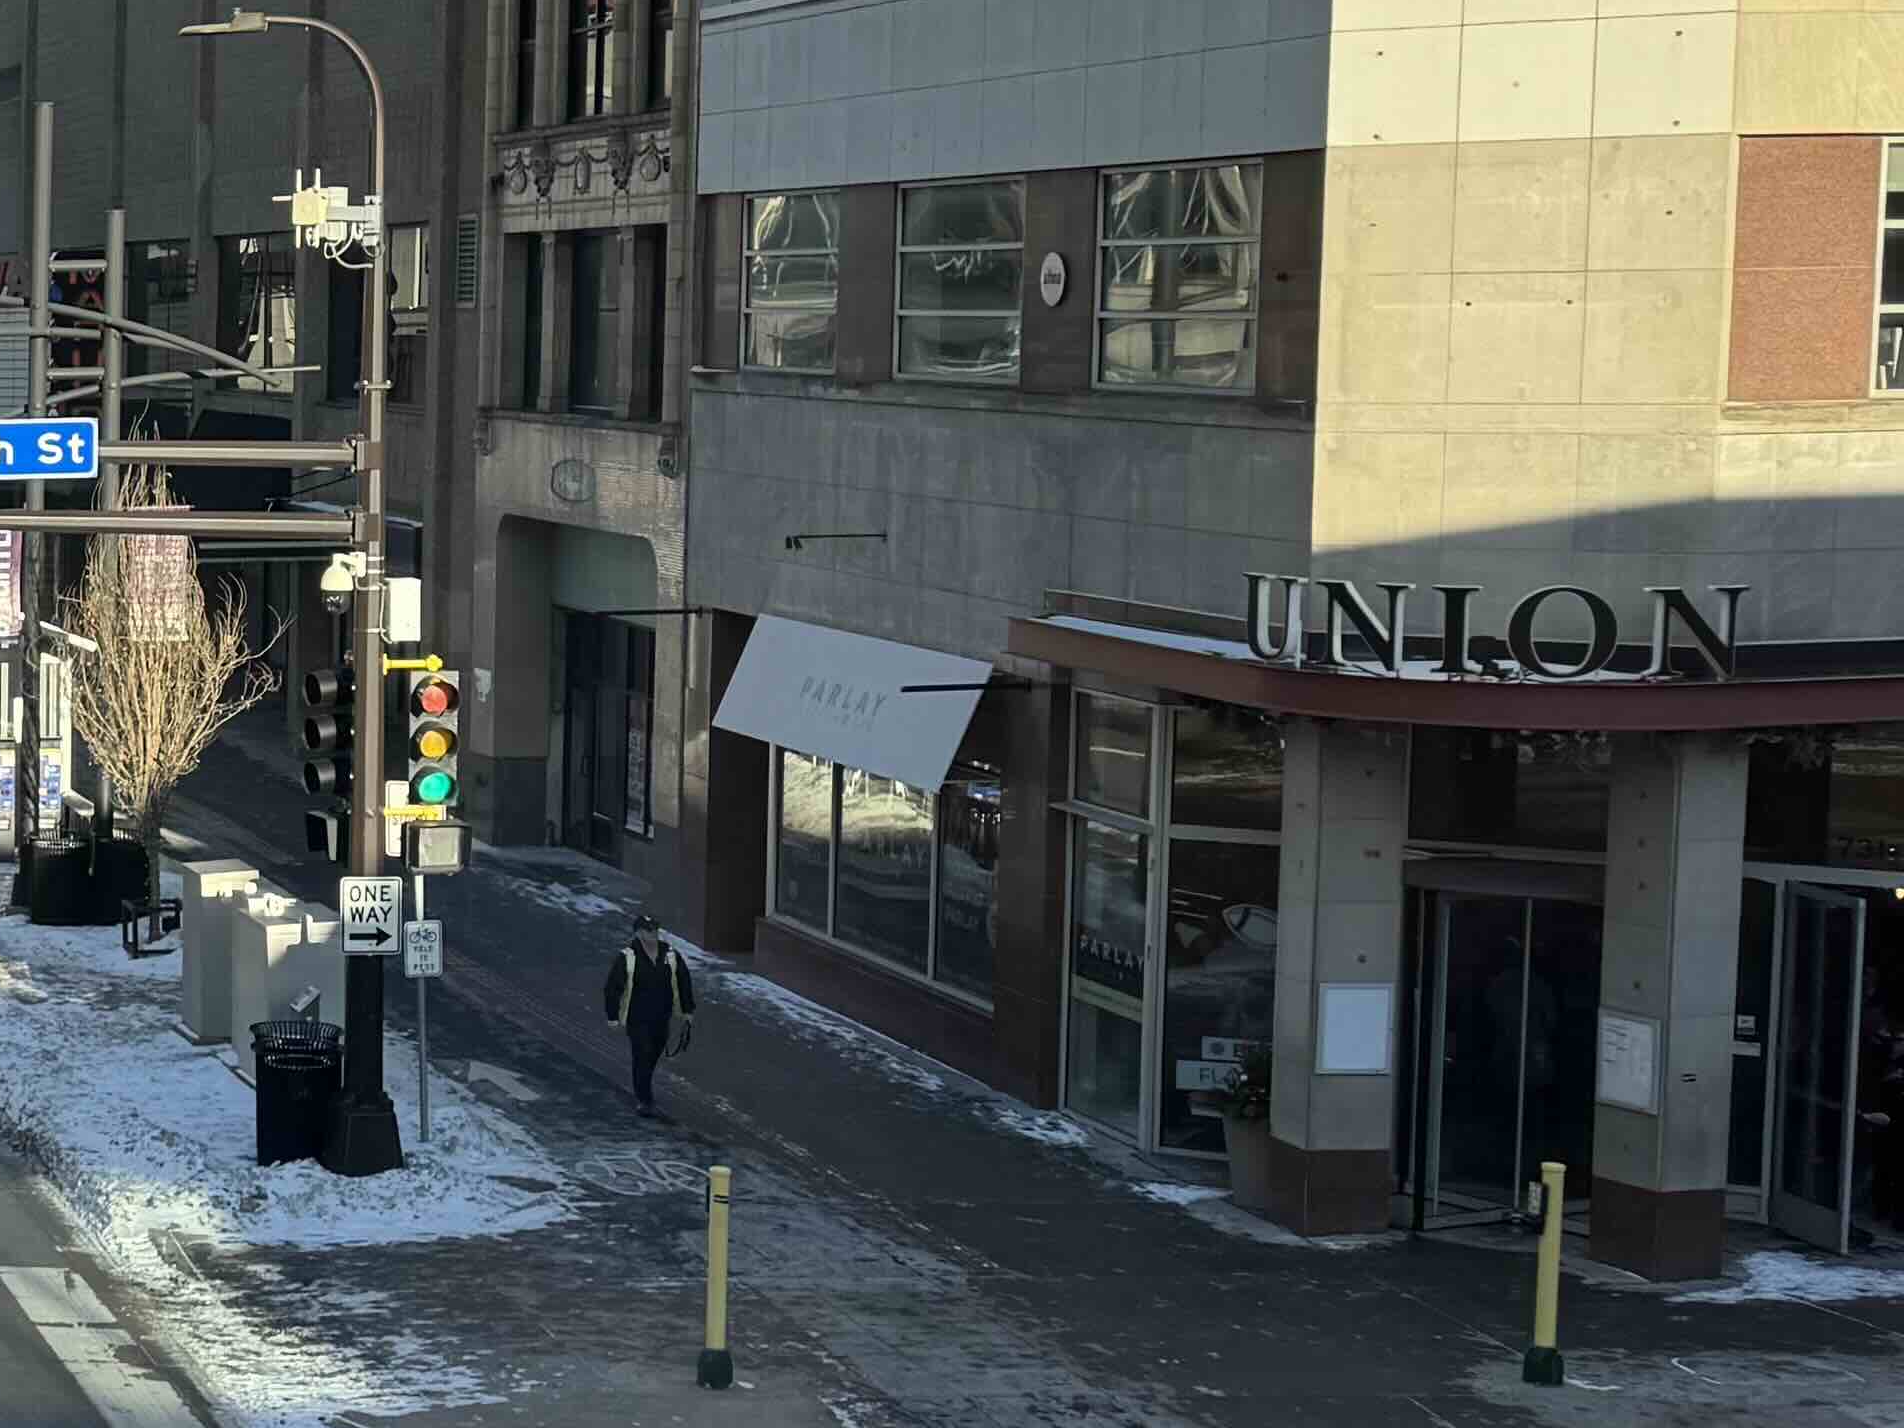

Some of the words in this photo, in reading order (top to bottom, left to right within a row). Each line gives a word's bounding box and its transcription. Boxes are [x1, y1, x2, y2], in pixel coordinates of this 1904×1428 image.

[38, 431, 85, 465] St
[1241, 572, 1751, 682] UNION
[798, 675, 888, 717] PARLAY
[349, 885, 392, 903] ONE
[350, 905, 393, 923] WAY
